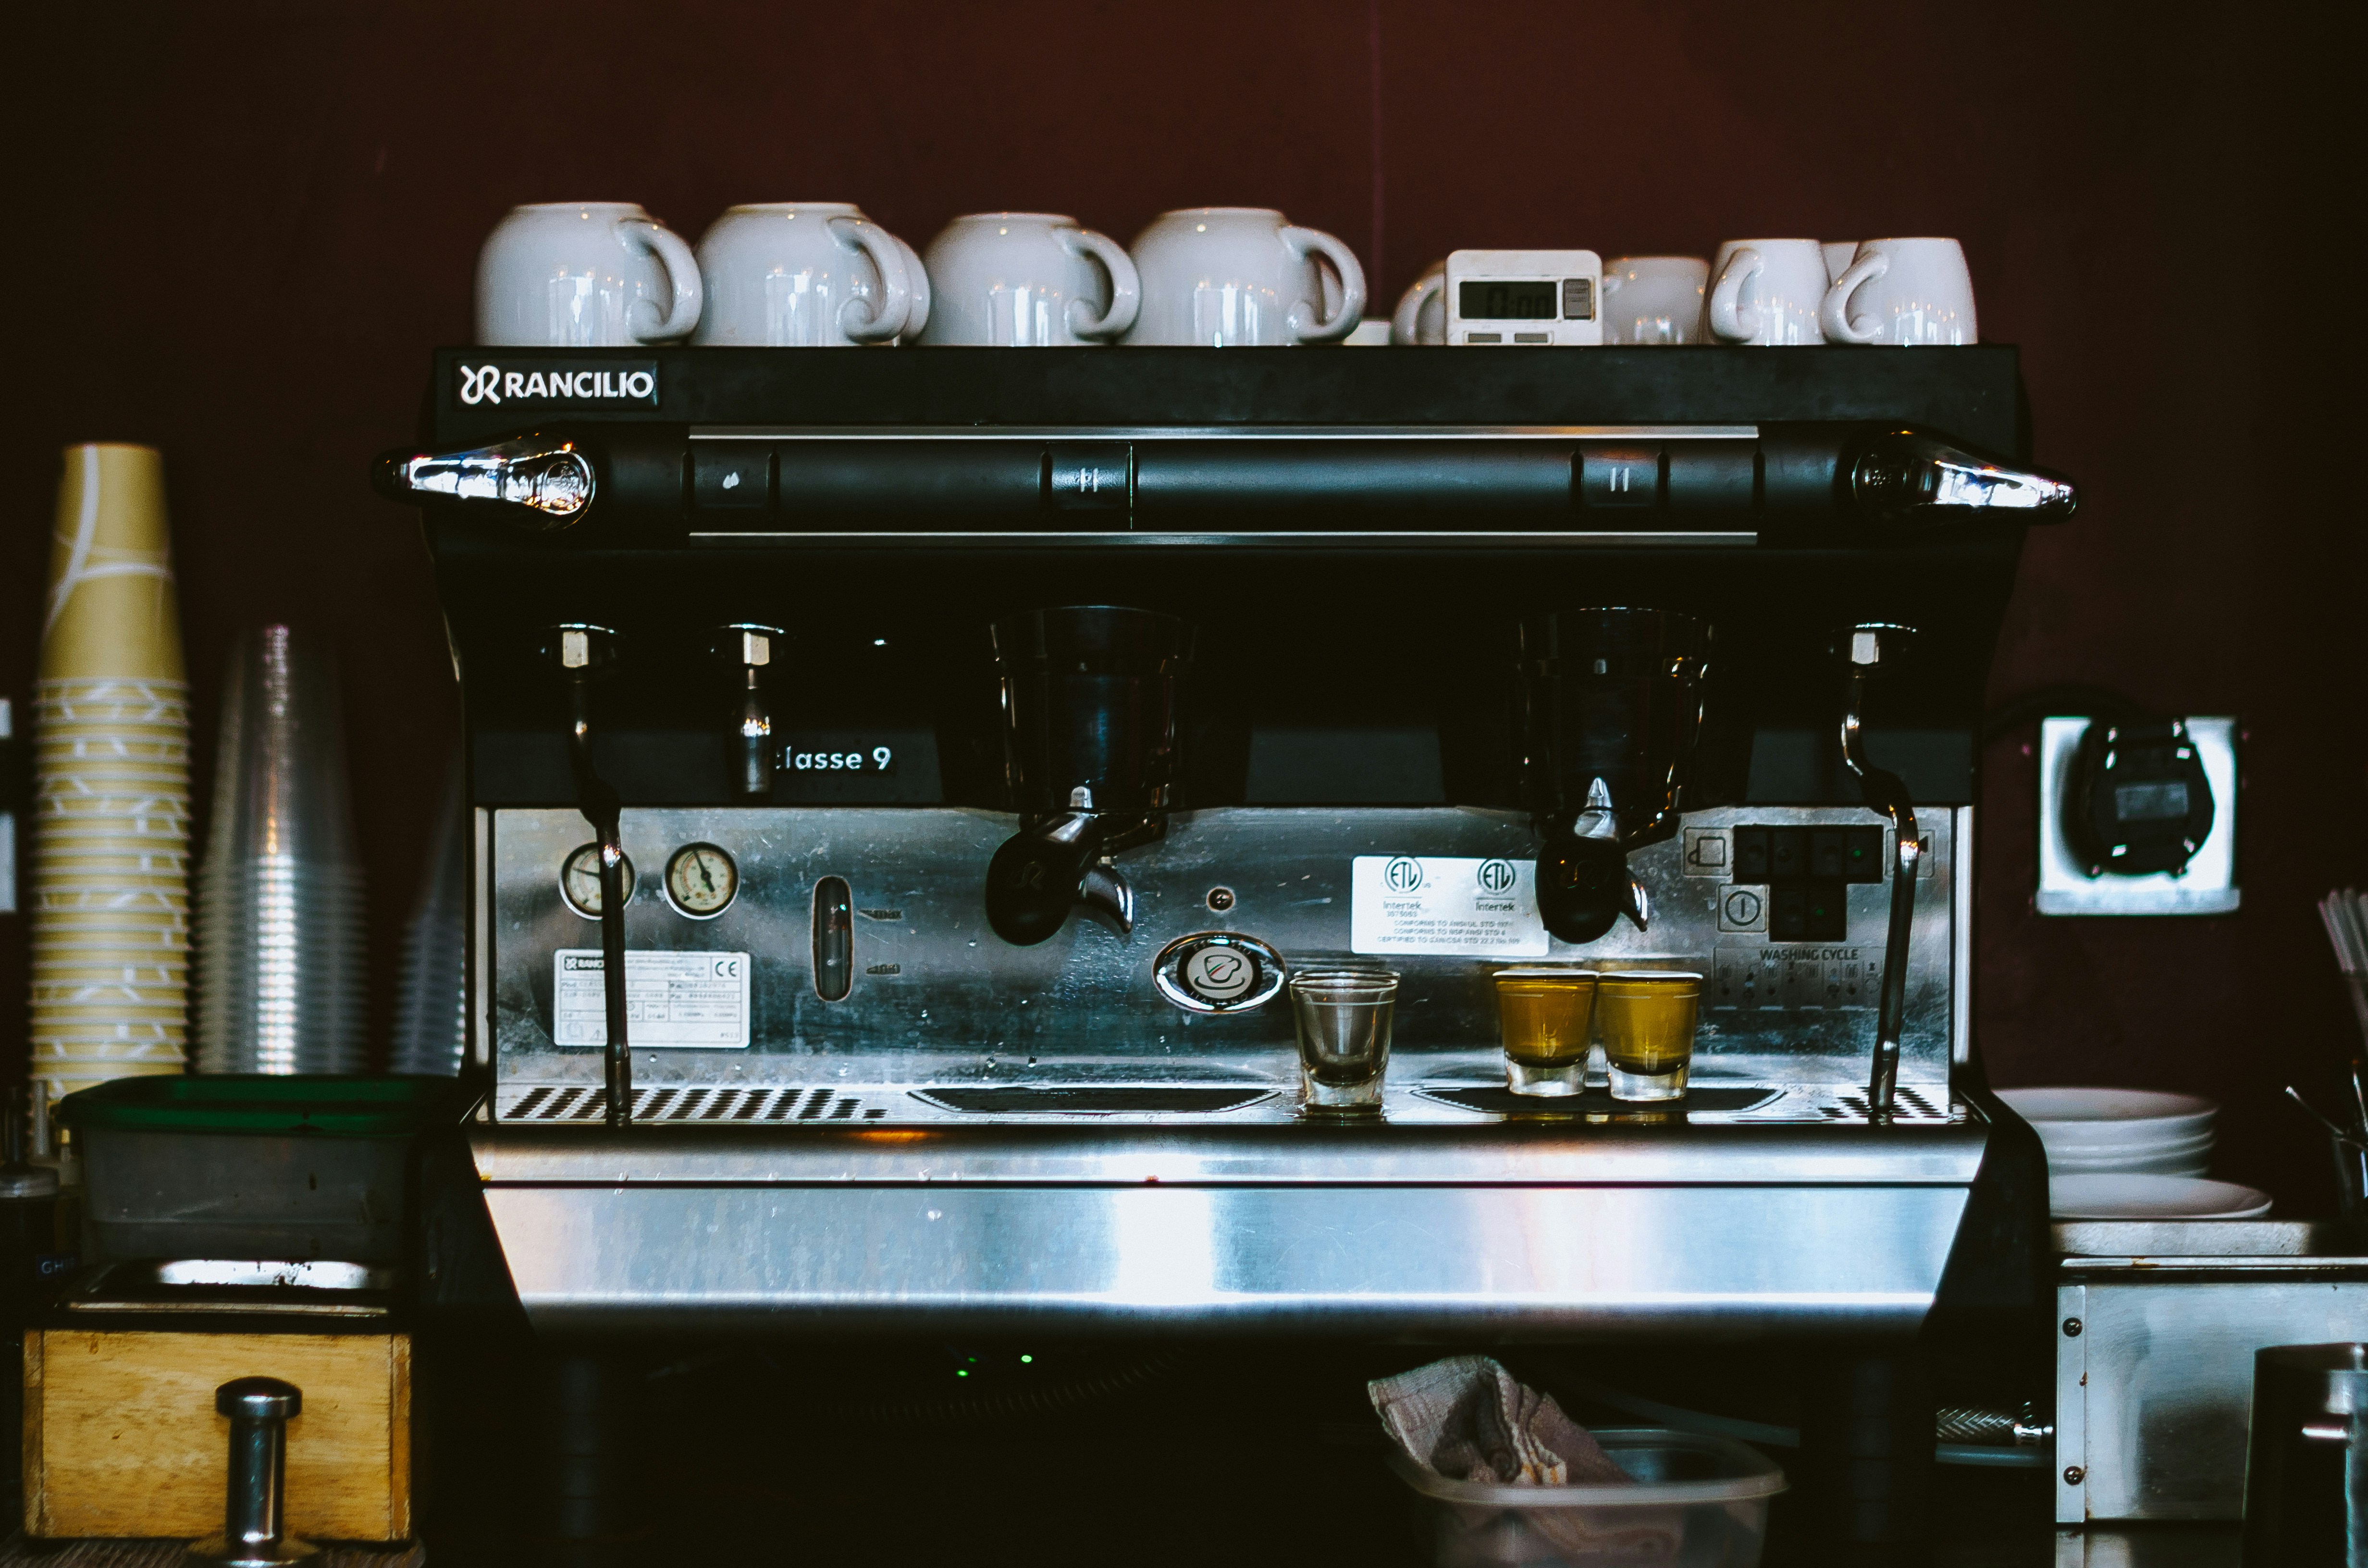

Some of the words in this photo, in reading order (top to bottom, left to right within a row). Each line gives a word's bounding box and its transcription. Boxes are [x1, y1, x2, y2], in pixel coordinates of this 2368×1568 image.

[505, 371, 654, 398] RANCILIO
[873, 747, 891, 770] 9
[1383, 901, 1422, 910] Intertek
[1476, 902, 1514, 912] Intertek
[1760, 948, 1820, 961] WASHING
[1821, 949, 1859, 961] CYCLE
